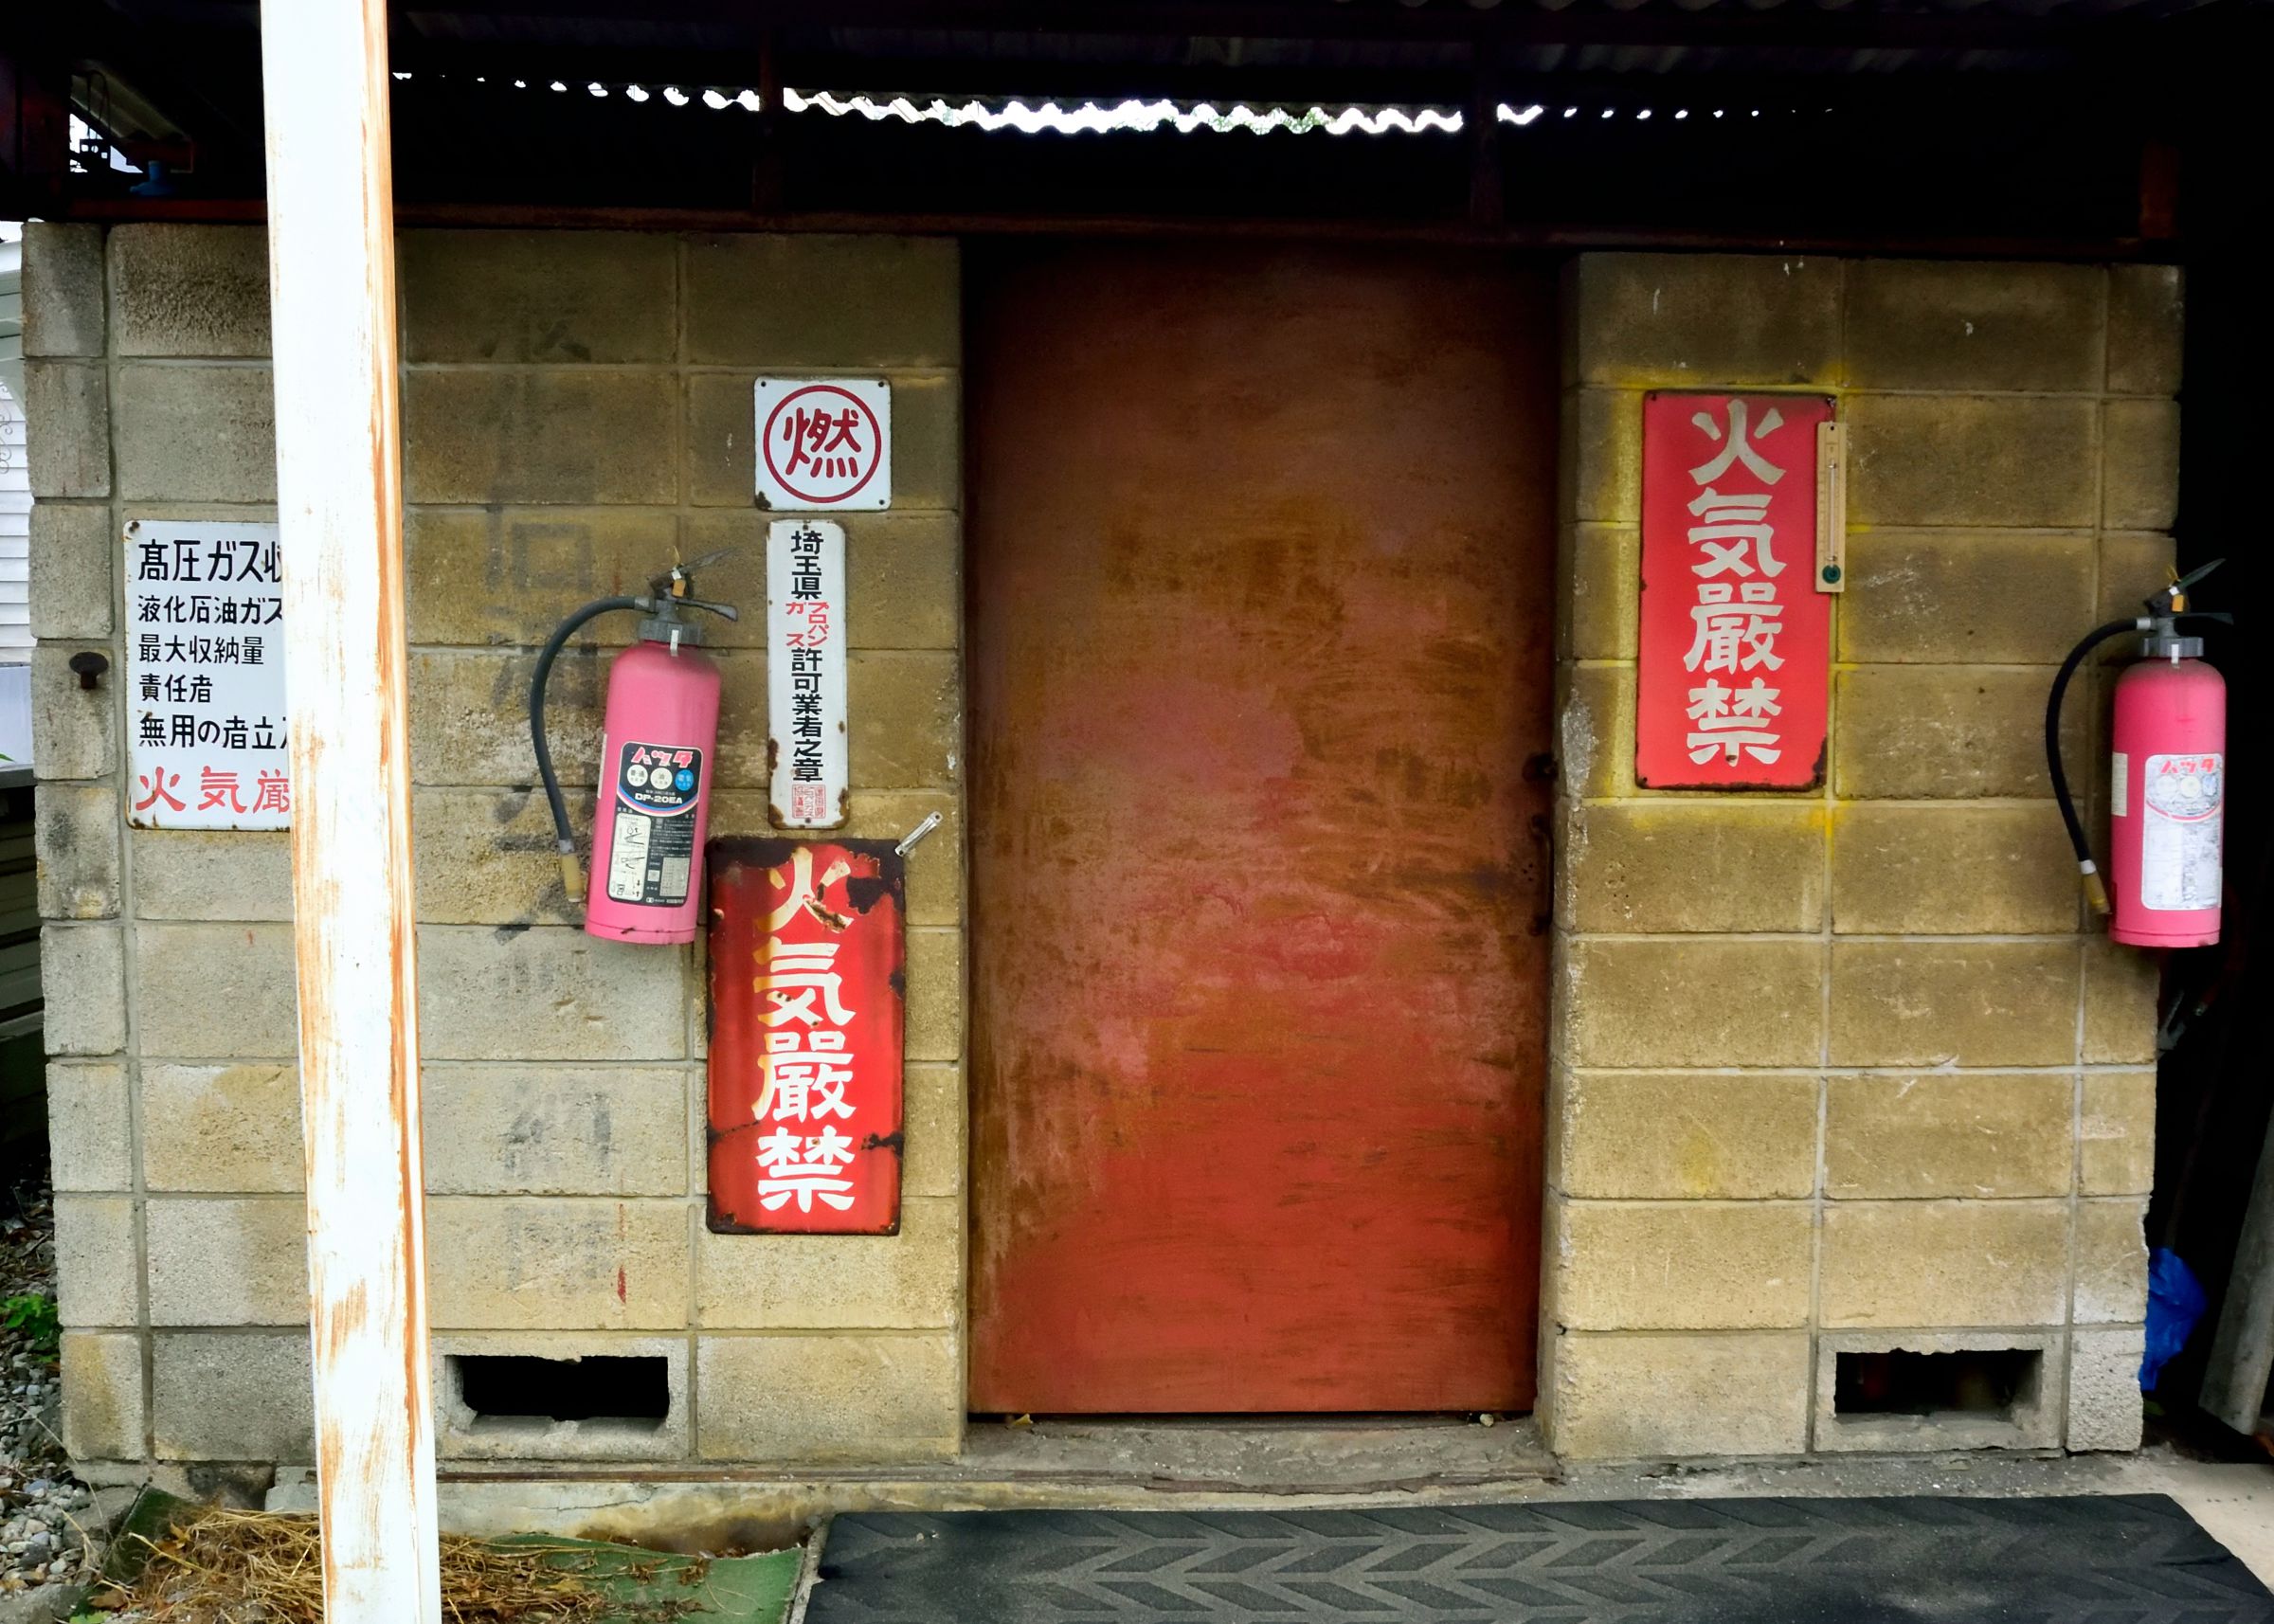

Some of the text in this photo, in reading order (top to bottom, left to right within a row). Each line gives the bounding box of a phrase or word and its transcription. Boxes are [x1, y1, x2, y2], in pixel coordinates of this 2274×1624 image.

[783, 407, 861, 478] 燃
[790, 530, 823, 600] 埼玉県
[137, 594, 283, 625] 液化石油ガス
[807, 602, 830, 647] プロパン
[138, 634, 265, 665] 最大収納量
[139, 674, 213, 703] 責任者
[791, 647, 823, 783] 許可業者之章
